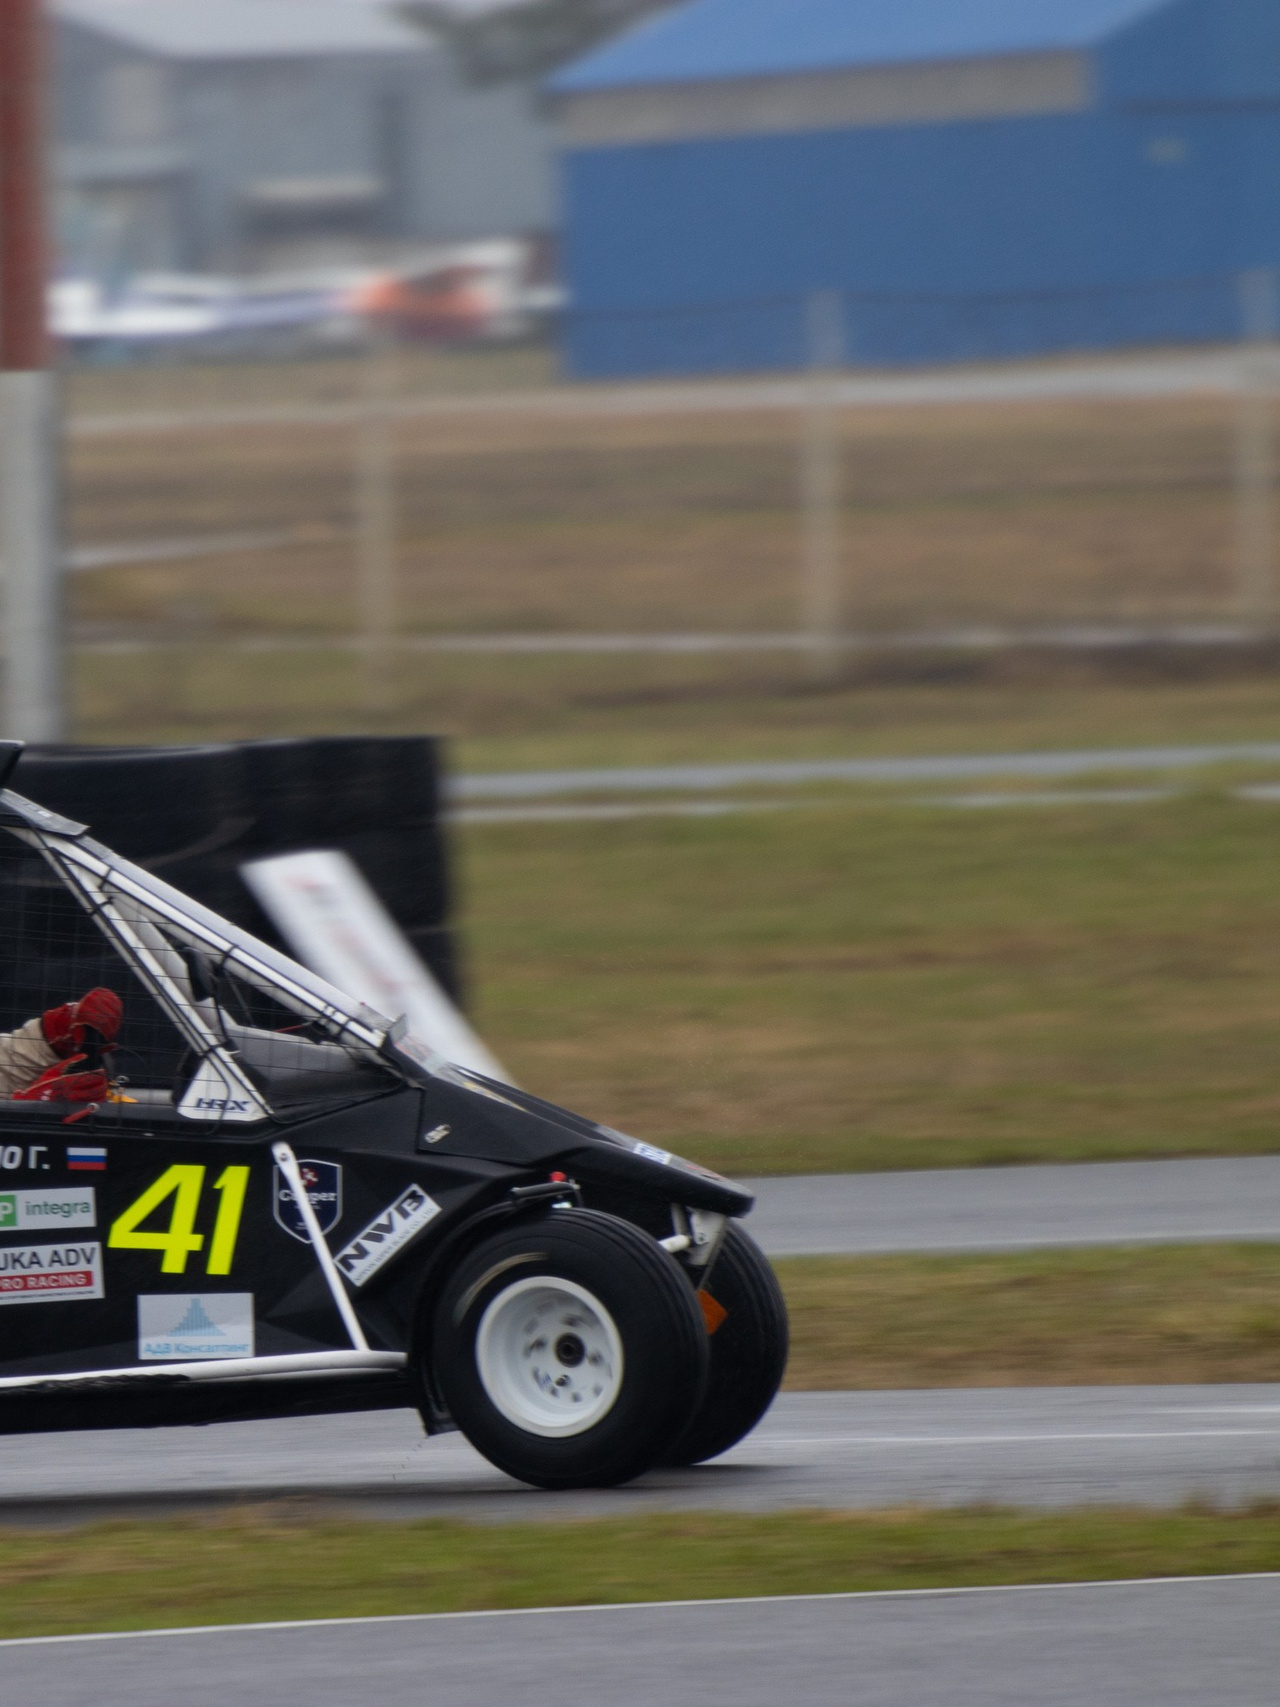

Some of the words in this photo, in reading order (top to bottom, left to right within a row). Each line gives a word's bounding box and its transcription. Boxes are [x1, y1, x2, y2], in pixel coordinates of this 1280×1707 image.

[29, 1146, 51, 1170] Г.
[25, 1199, 92, 1219] integra
[107, 1164, 251, 1275] 41
[337, 1190, 427, 1273] NWB
[47, 1247, 96, 1268] ADV
[28, 1274, 87, 1289] RACING
